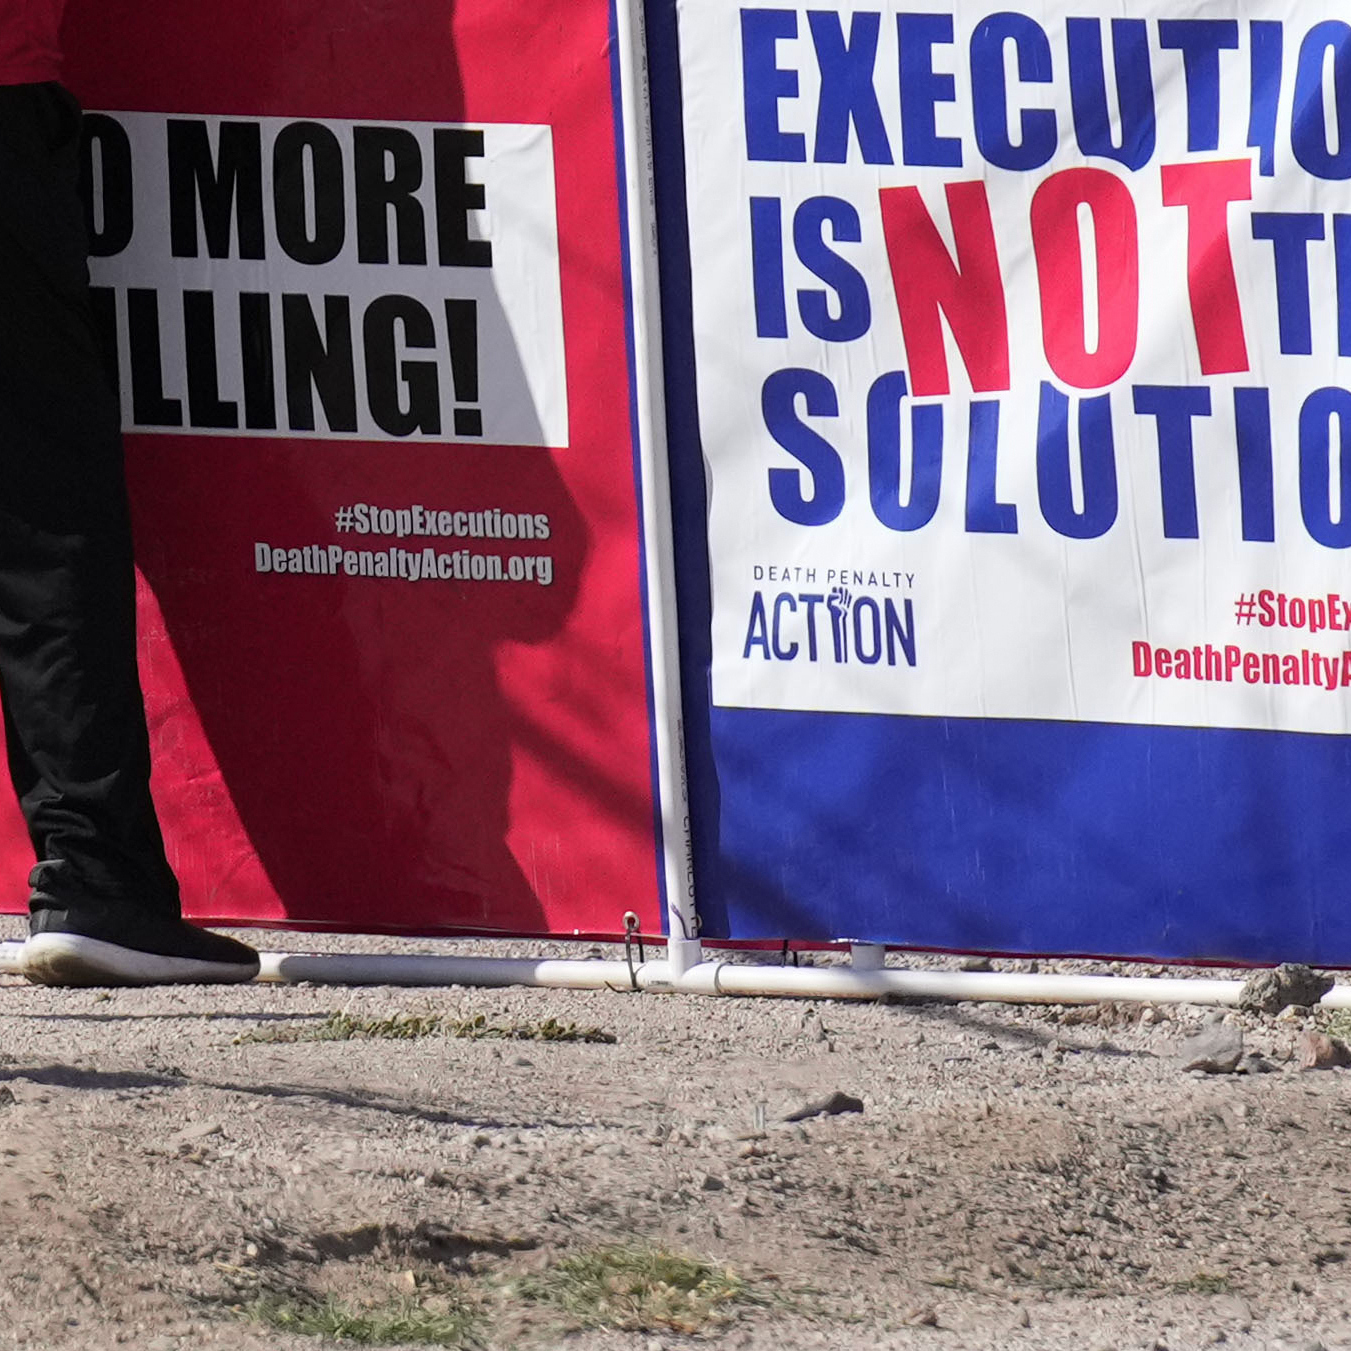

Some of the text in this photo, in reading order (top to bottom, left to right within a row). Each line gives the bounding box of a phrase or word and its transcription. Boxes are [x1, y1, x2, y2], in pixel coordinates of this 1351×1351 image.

[167, 114, 492, 267] MORE
[750, 197, 871, 342] IS
[880, 159, 1251, 396] NOT
[336, 504, 549, 538] #StopExecutions
[256, 543, 552, 584] DeathPenaltyAction.org
[753, 566, 916, 589] DEATH PENALTY
[743, 588, 917, 667] ACTION
